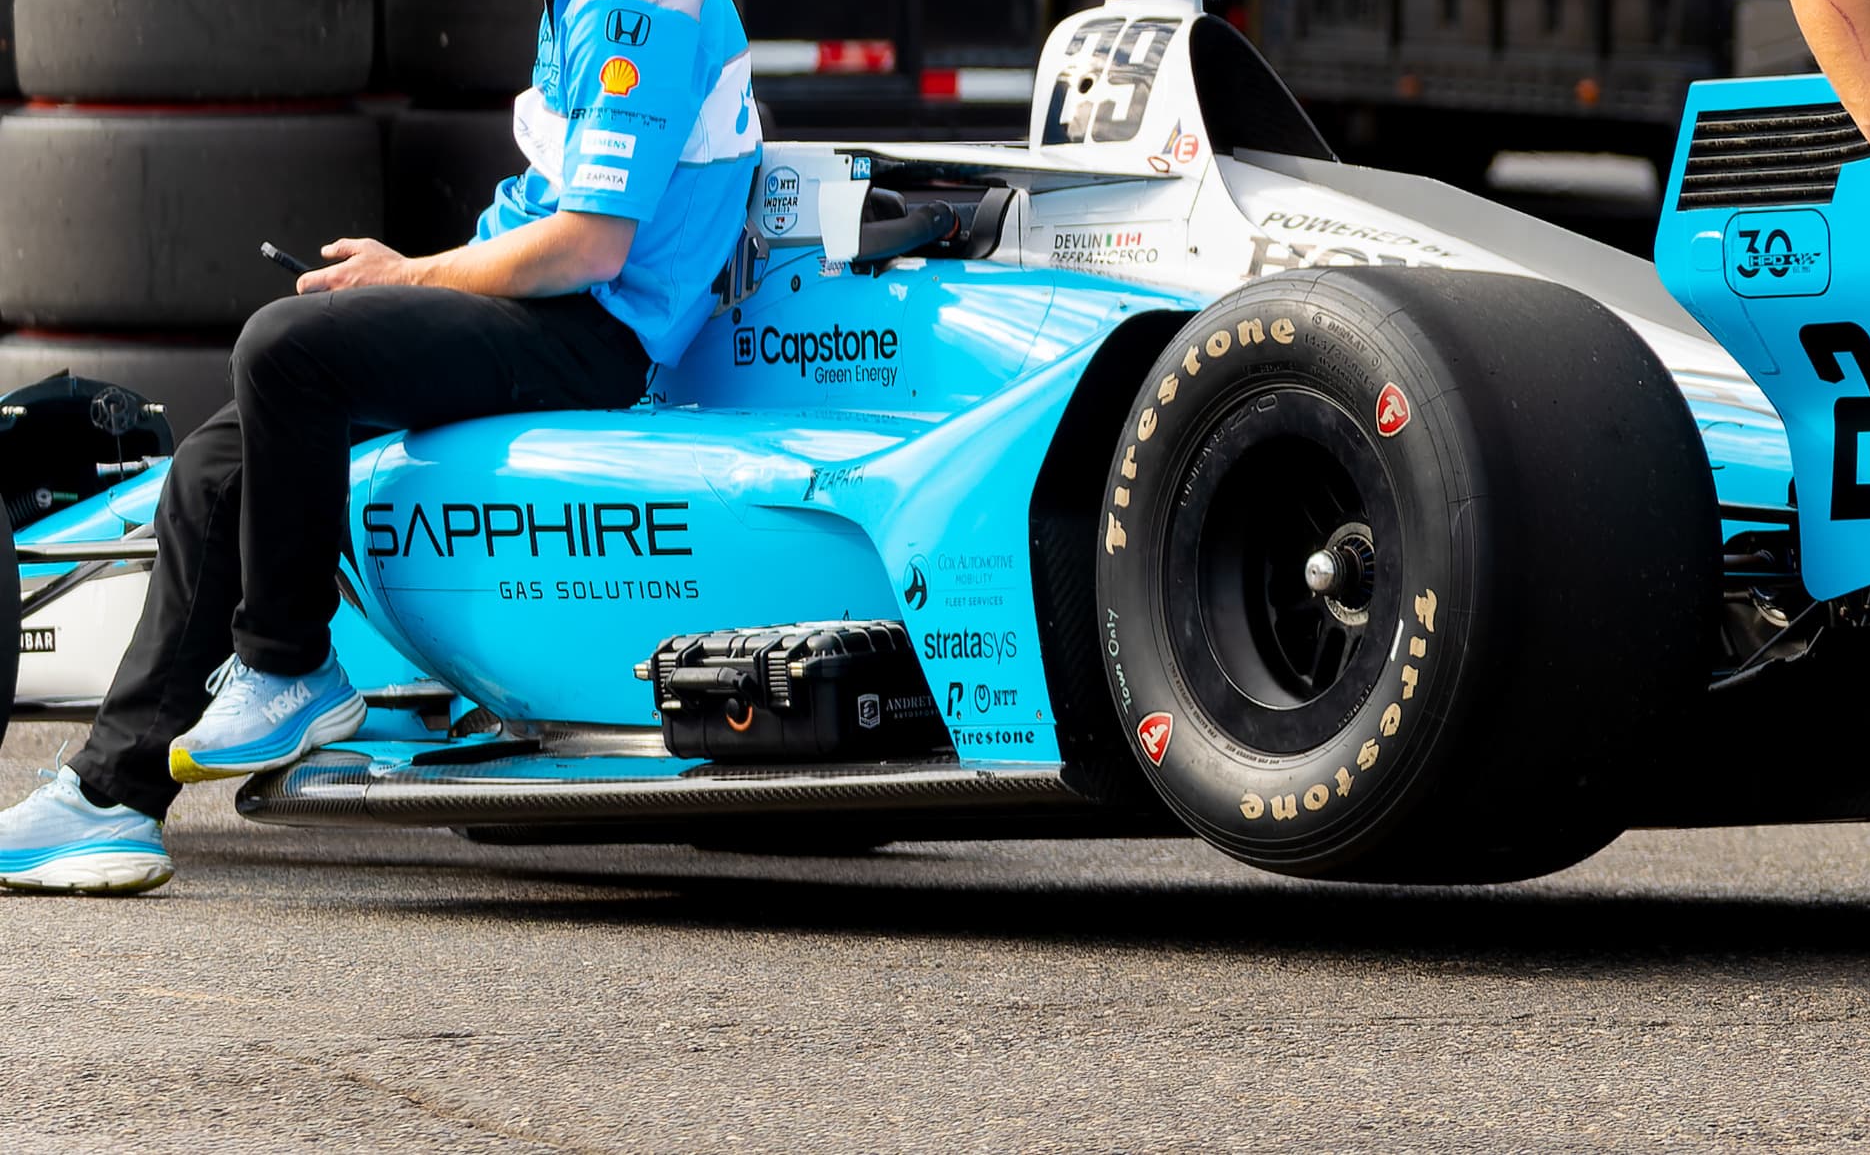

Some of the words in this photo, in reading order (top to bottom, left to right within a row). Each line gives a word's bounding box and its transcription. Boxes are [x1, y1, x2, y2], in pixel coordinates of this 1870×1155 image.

[780, 179, 796, 190] NTT
[764, 196, 799, 209] INDYCAR
[1053, 232, 1103, 250] DEVLIN
[1260, 211, 1420, 247] POWERED
[1736, 229, 1793, 279] 30
[759, 325, 899, 378] Capstone
[814, 365, 850, 384] Green
[852, 364, 898, 389] Energy
[1103, 314, 1298, 557] Firestone
[362, 500, 693, 558] SAPPHIRE
[499, 581, 545, 601] GAS
[556, 579, 700, 601] SOLUTIONS
[924, 626, 1017, 665] stratasys
[260, 680, 312, 723] HOKA
[885, 695, 932, 712] ANDRET
[993, 689, 1018, 706] NTT
[1239, 588, 1438, 822] Firestone
[952, 728, 1035, 747] Firestone
